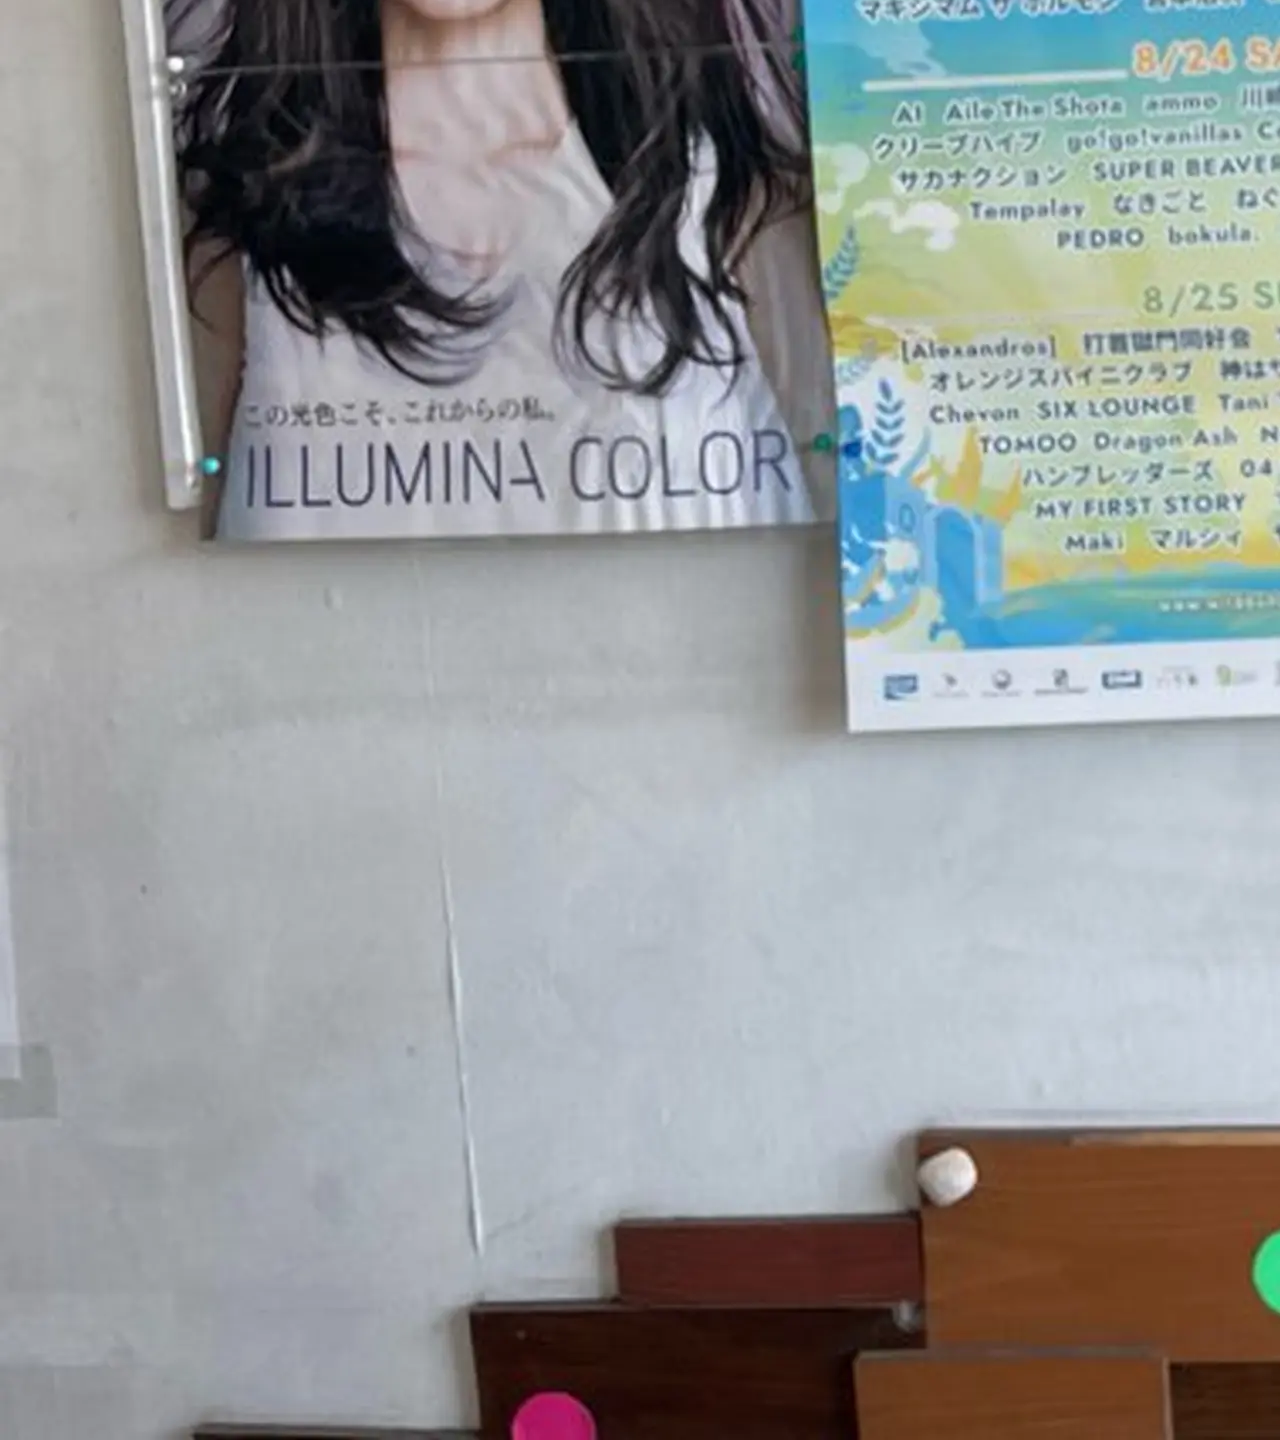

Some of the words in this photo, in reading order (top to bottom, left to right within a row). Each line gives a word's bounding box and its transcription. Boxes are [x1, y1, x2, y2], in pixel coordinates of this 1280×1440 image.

[1133, 37, 1233, 80] 8/24
[945, 97, 996, 123] Aile
[1000, 98, 1047, 122] The
[1053, 93, 1126, 119] Shota
[1145, 94, 1219, 113] ammo
[874, 129, 1042, 161] クリープハイプ
[1067, 122, 1243, 153] go!go!vanillas
[897, 166, 1066, 192] サカナクション
[1093, 158, 1175, 182] SUPER
[969, 198, 1086, 223] Tempalay
[1112, 189, 1206, 215] なきごと
[1056, 227, 1145, 251] PEDRO
[1142, 282, 1239, 317] 8/25
[901, 332, 1058, 364] [Alexandros]
[929, 359, 1193, 394] オレンジスパイニクラブ
[929, 402, 1020, 425] Chevon
[1037, 397, 1078, 421] SIX
[1088, 393, 1197, 418] LOUNGE
[1218, 392, 1270, 412] Tani
[979, 432, 1077, 455] TOMOO
[1094, 429, 1183, 456] Dragon
[1193, 425, 1239, 446] Ash
[246, 438, 546, 508] ILLUMINA
[569, 429, 792, 502] COLOR
[1240, 459, 1272, 478] 04
[1035, 500, 1074, 520] MY
[1084, 496, 1154, 518] FIRST
[1164, 493, 1247, 516] STORY
[1064, 533, 1125, 553] Maki
